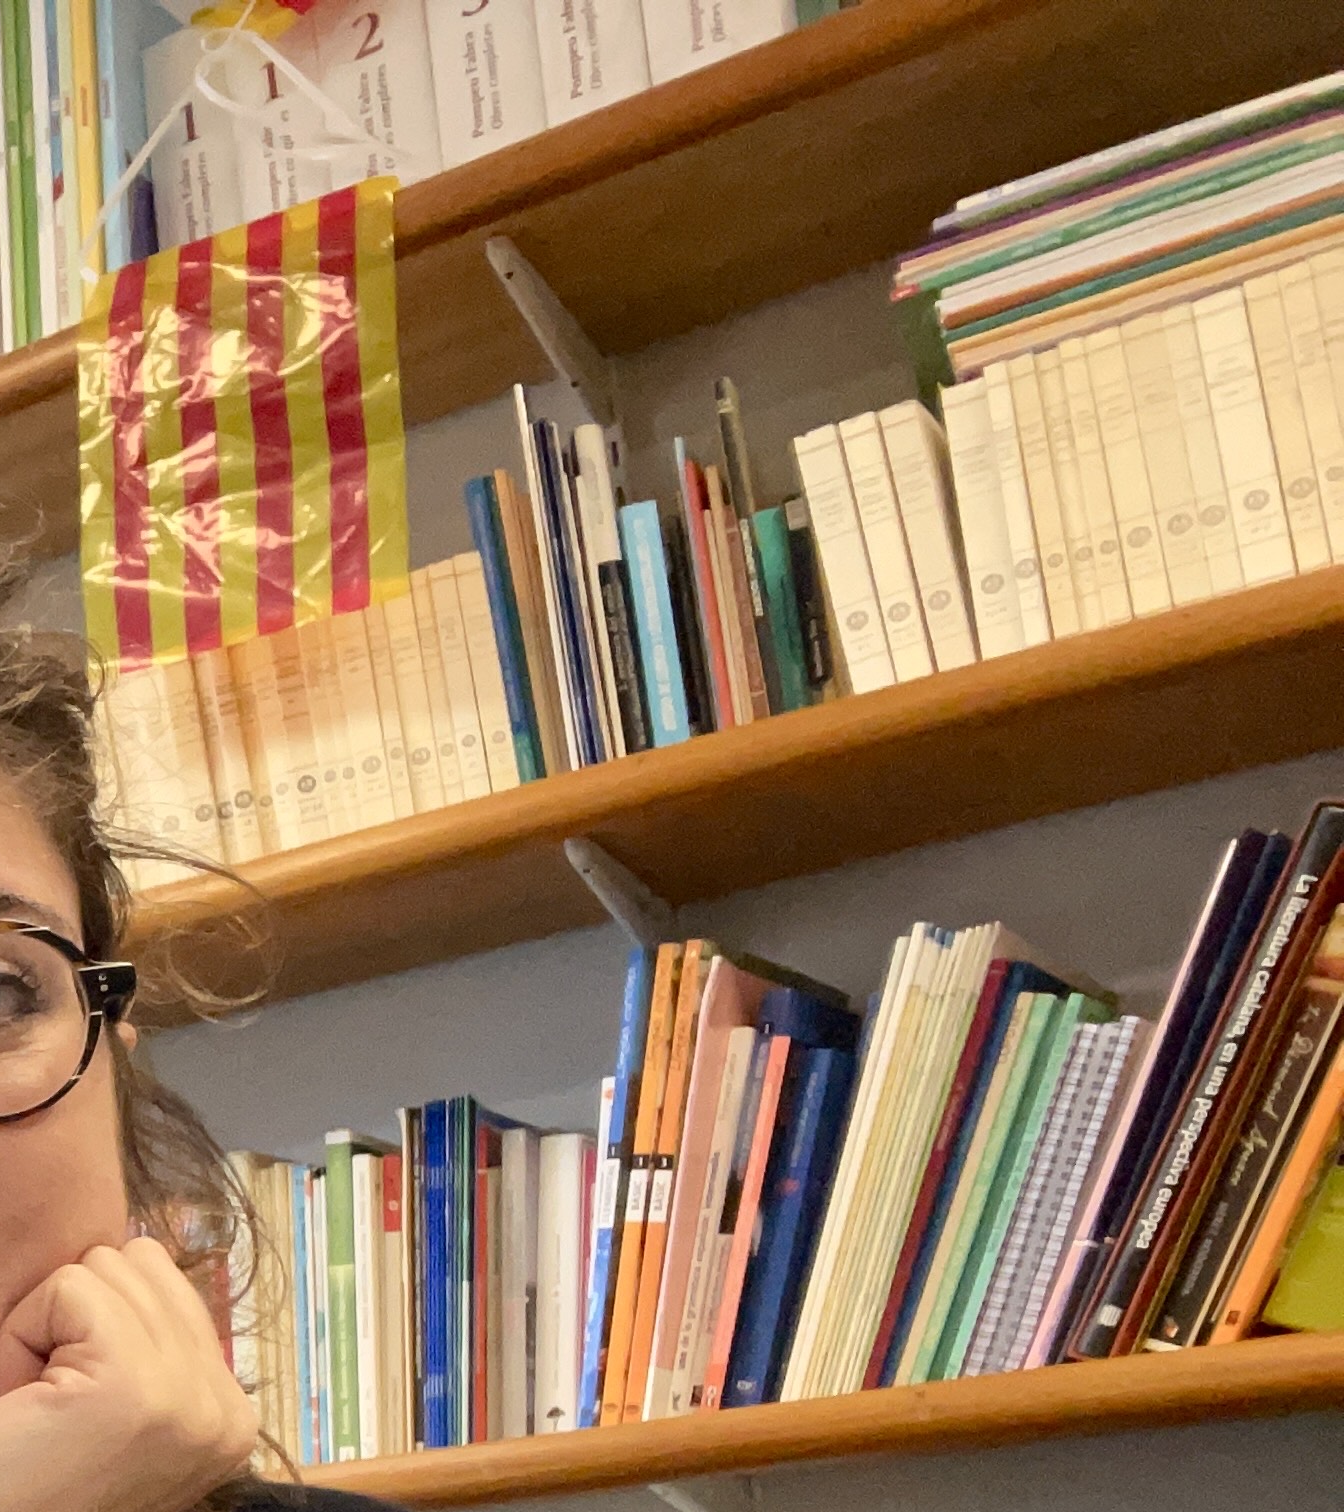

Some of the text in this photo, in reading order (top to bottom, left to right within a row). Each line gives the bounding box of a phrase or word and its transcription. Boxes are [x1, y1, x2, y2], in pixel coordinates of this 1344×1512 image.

[352, 12, 384, 61] 2
[260, 61, 283, 104] 1
[183, 101, 200, 145] 1
[1296, 874, 1318, 893] La
[1261, 897, 1309, 967] literatura
[1219, 1042, 1238, 1063] en
[1205, 1065, 1228, 1096] una
[1165, 1098, 1212, 1186] perspectiva
[1136, 1187, 1172, 1249] europea
